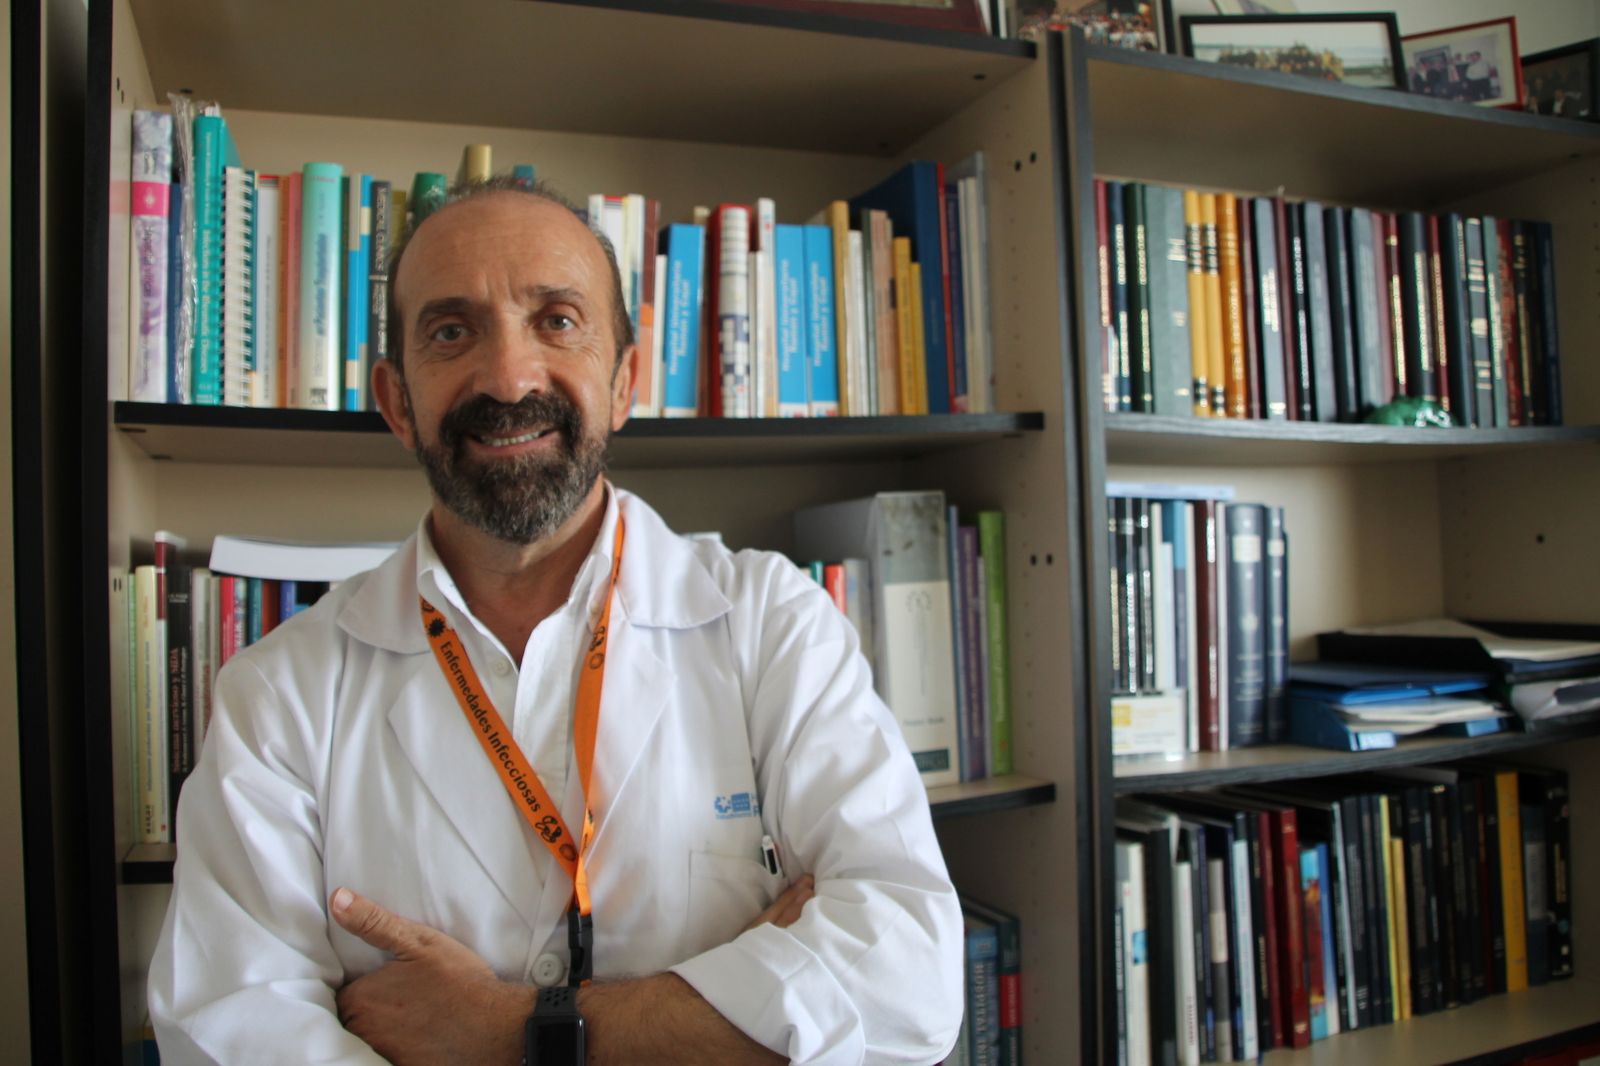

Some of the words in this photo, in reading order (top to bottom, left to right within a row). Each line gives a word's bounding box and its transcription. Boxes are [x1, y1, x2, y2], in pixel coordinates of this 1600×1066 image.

[169, 648, 179, 673] SIDA
[440, 641, 492, 733] Enfermedades
[487, 732, 541, 813] Infecciosas
